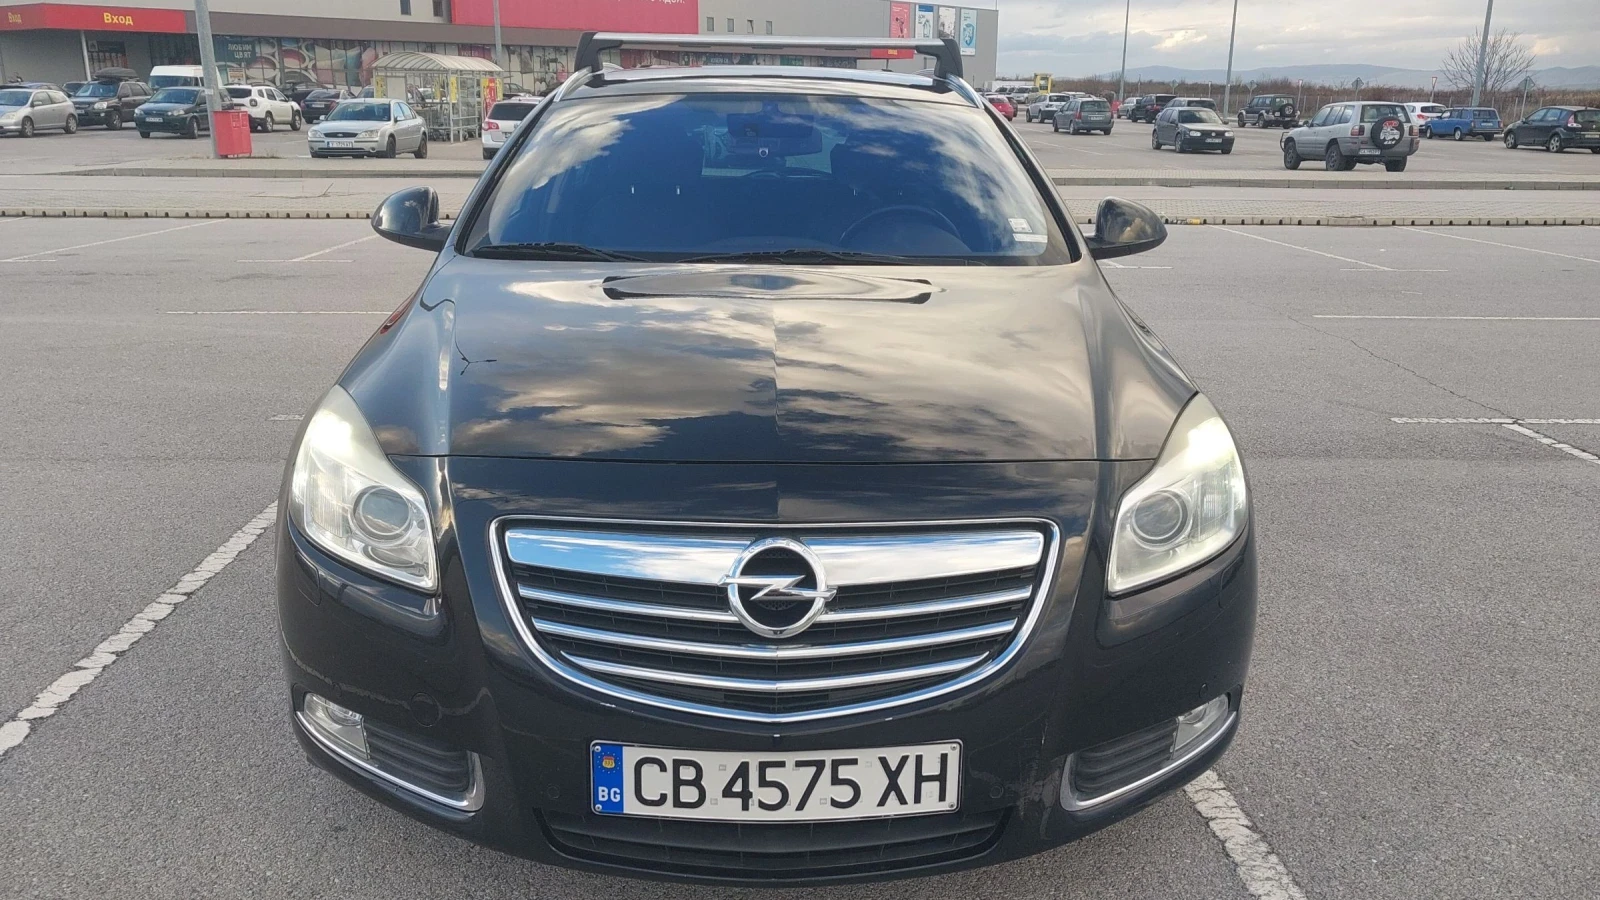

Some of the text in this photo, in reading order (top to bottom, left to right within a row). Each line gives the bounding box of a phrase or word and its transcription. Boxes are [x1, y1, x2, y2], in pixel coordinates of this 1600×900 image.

[103, 12, 133, 25] Вход
[228, 43, 252, 51] ЛЮБИМ
[234, 51, 251, 59] ЦВЯТ
[633, 753, 949, 812] CB 4575 XH
[598, 786, 621, 802] BG
